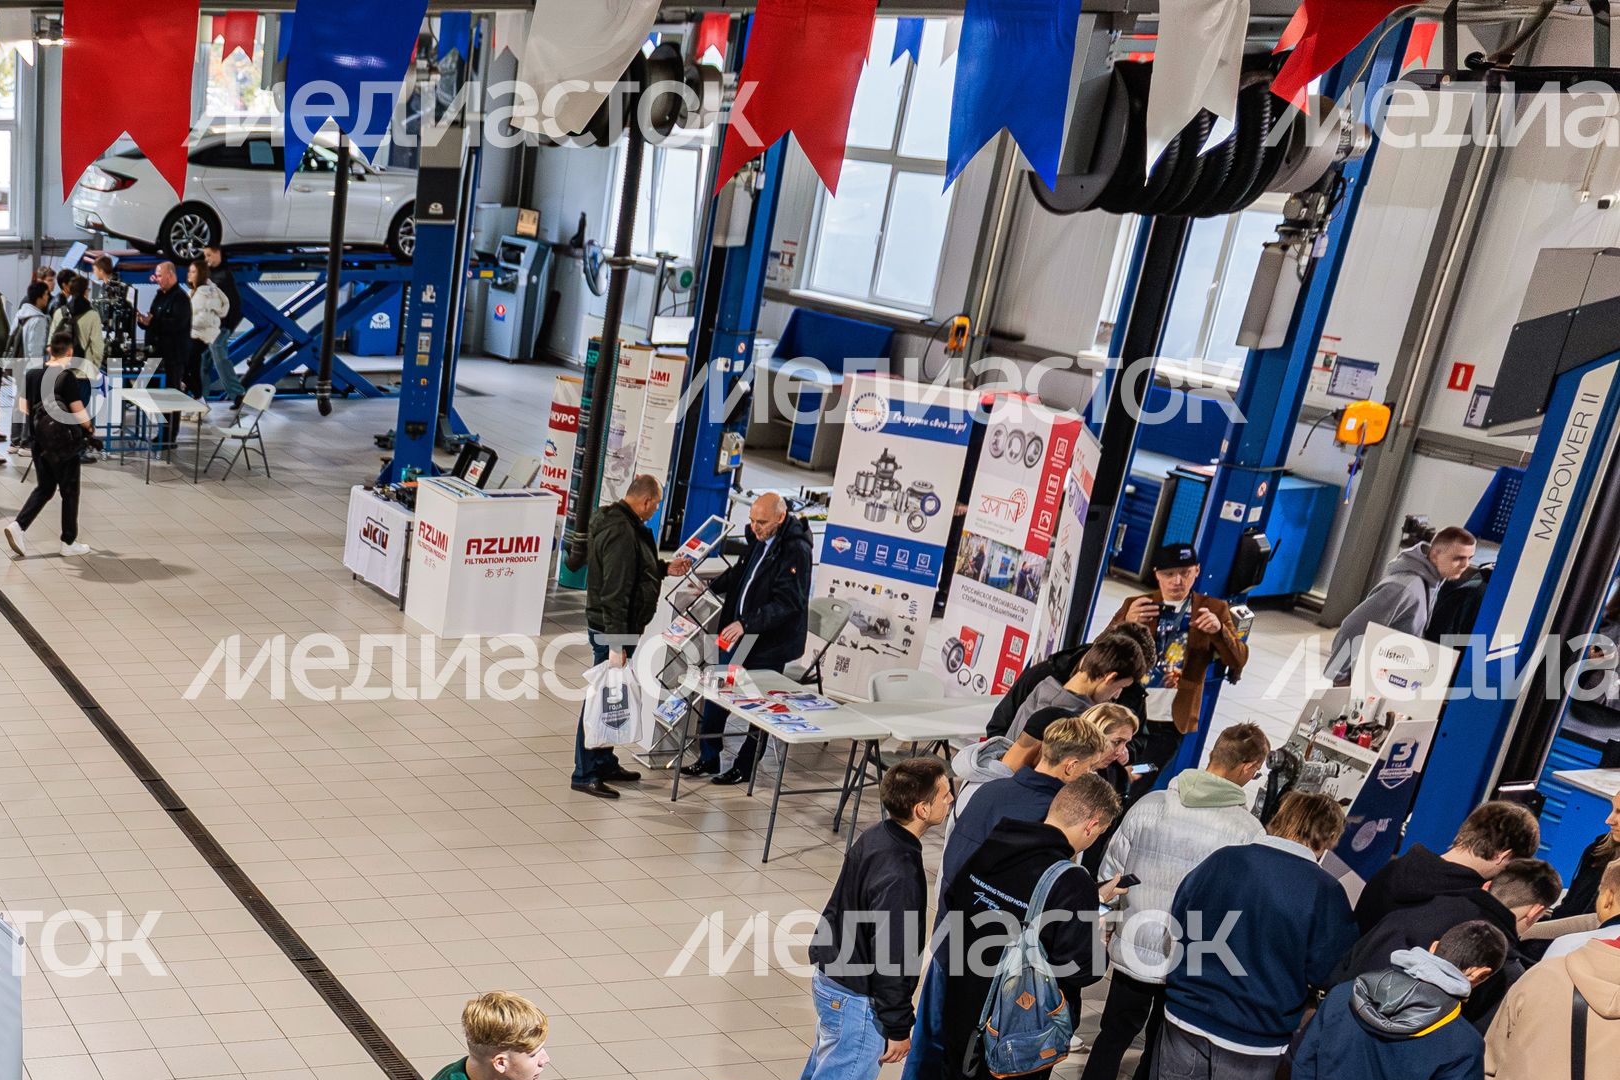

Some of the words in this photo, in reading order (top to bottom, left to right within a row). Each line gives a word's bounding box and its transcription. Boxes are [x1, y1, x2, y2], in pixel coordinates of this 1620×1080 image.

[1534, 411, 1594, 540] MAPOWER
[419, 520, 449, 553] AZUMI
[466, 535, 541, 556] AZUMI
[465, 557, 504, 565] FILTRATION
[505, 555, 538, 564] PRODUCT
[484, 567, 515, 579] あずみ
